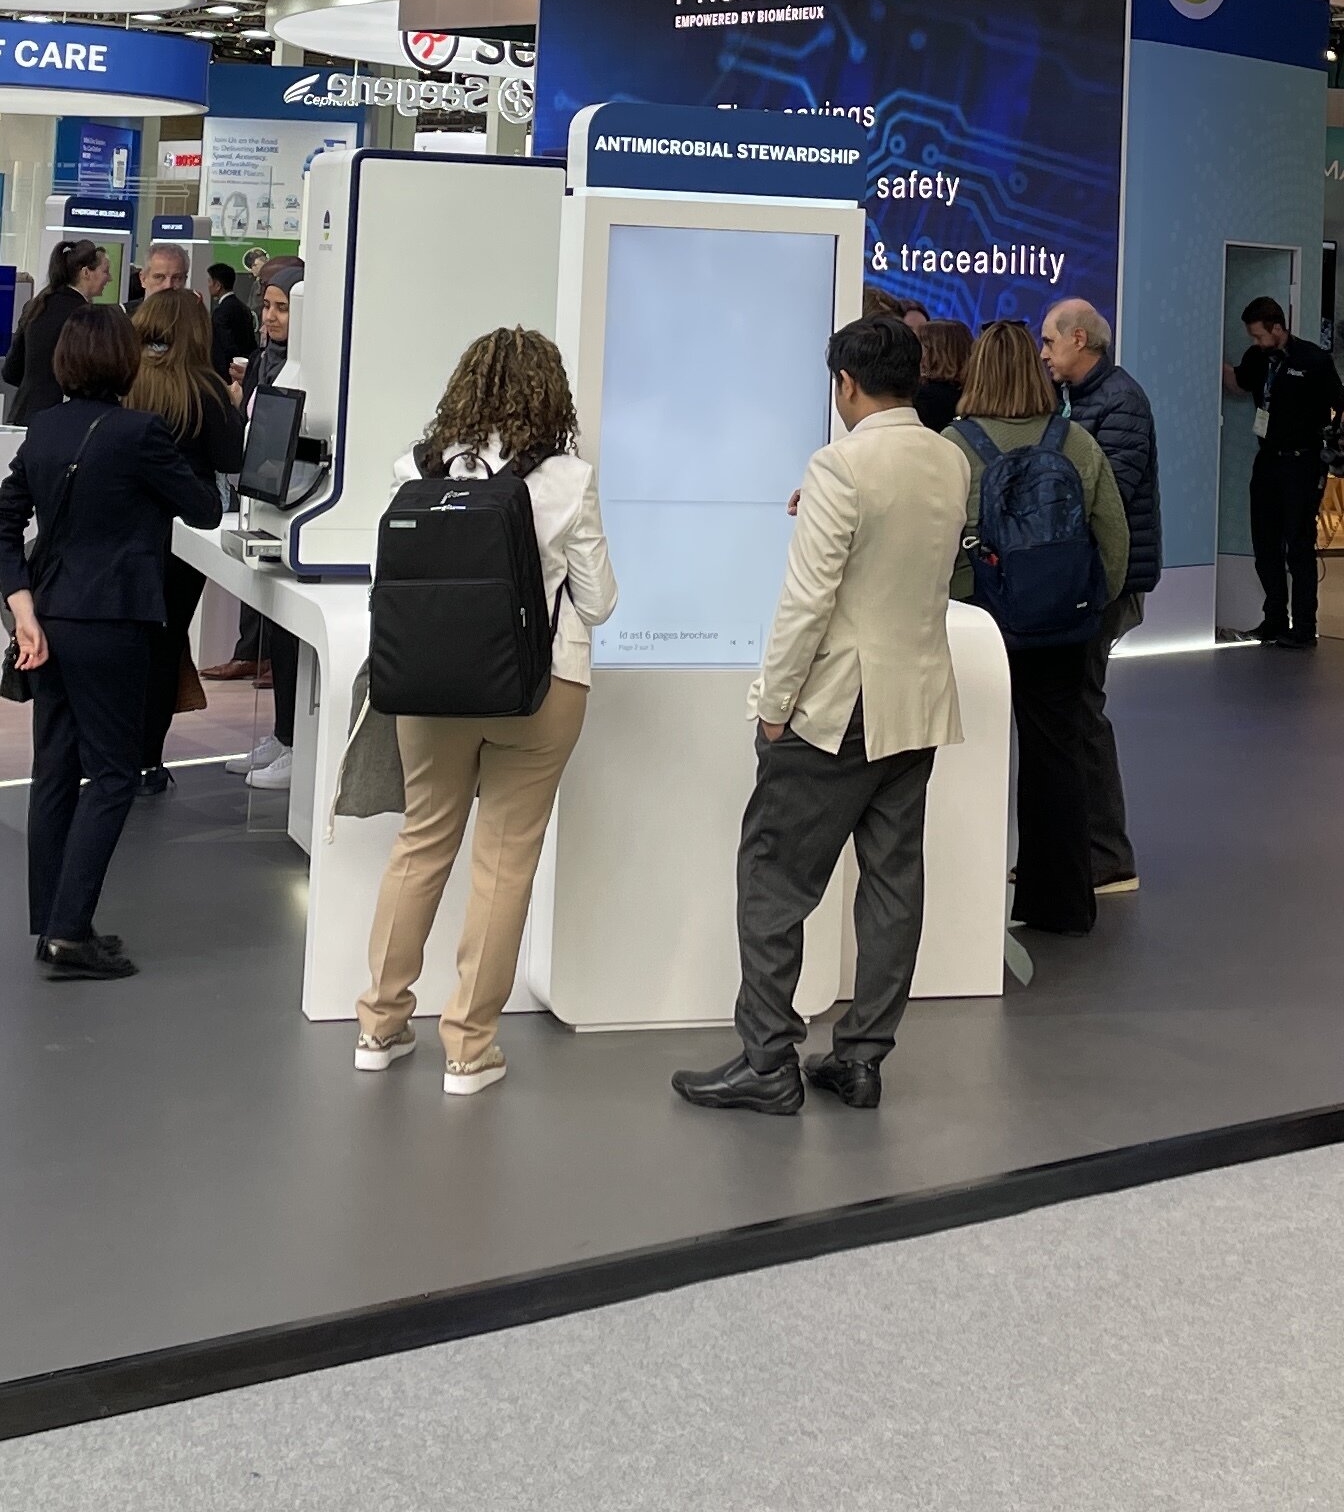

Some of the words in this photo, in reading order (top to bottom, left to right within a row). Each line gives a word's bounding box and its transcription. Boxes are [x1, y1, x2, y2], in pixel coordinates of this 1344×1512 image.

[675, 12, 739, 29] EMPOWERED
[741, 10, 755, 24] BY
[757, 5, 824, 23] BIOMÉRIEUX
[14, 40, 108, 72] CARE
[595, 136, 733, 158] ANTIMICROBIAL
[737, 143, 860, 166] STEWARDSHIP
[876, 170, 960, 206] safety
[871, 242, 889, 271] &
[901, 242, 1065, 284] traceability
[653, 632, 678, 641] pages
[680, 631, 718, 639] brochure
